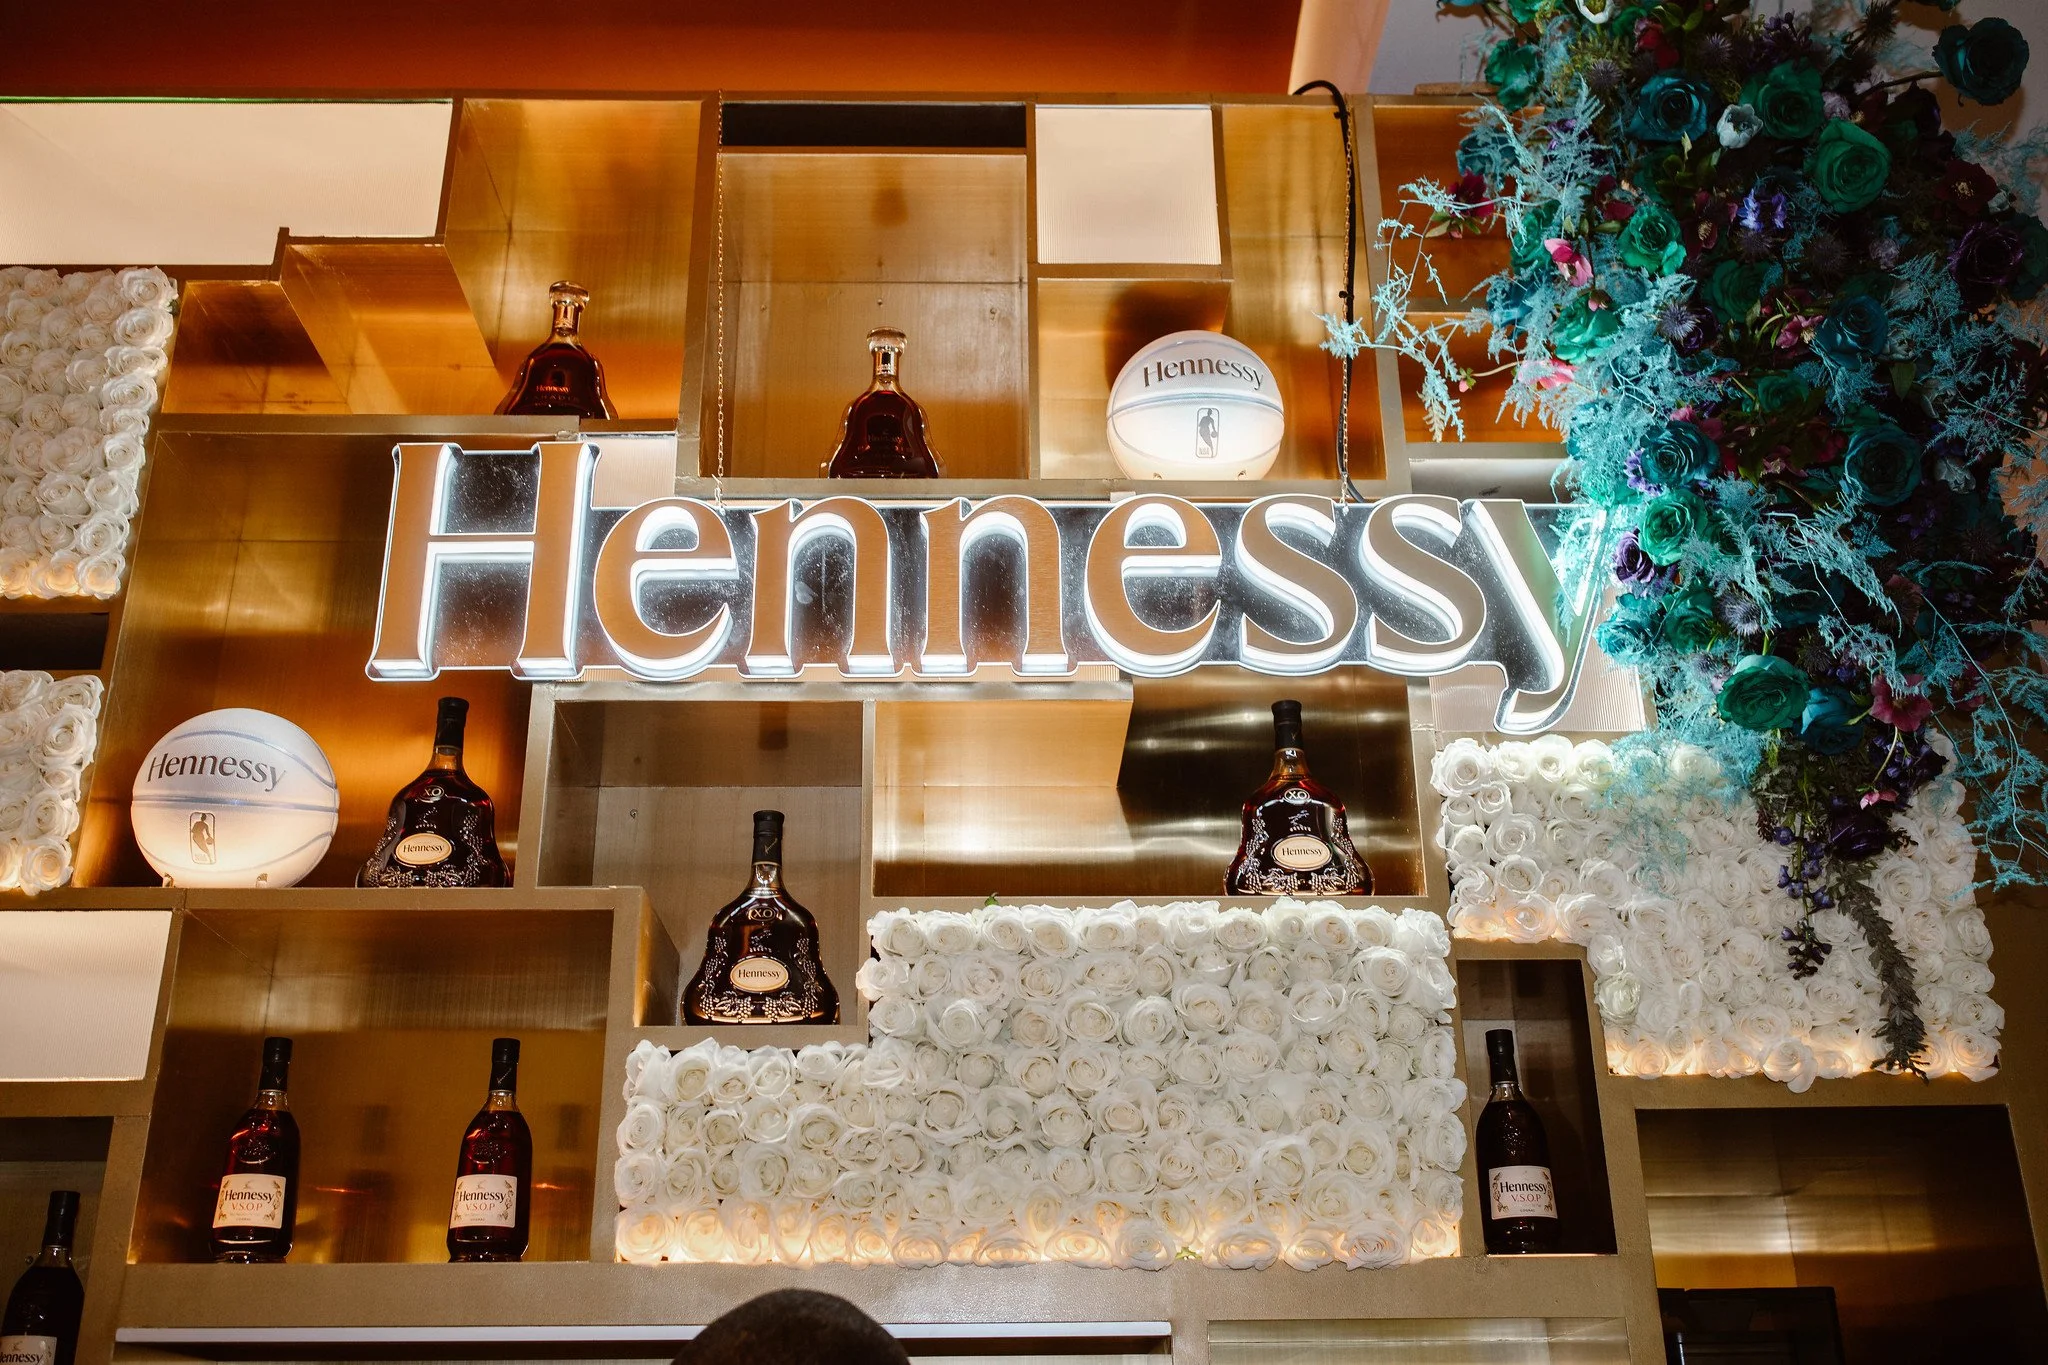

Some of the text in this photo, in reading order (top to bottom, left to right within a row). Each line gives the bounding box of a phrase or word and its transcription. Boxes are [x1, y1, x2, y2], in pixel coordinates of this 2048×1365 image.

[1144, 357, 1264, 391] Hennessy
[368, 441, 1608, 733] Hennessy
[147, 752, 286, 792] Hennessy
[403, 844, 445, 853] Hennessy
[1282, 847, 1323, 857] Hennessy
[738, 968, 781, 980] Hennessy
[1500, 1181, 1548, 1194] Hennessy
[225, 1189, 275, 1204] Hennessy
[459, 1190, 507, 1203] Hennessy
[1511, 1193, 1542, 1203] V.S.O.P
[231, 1202, 263, 1211] V.S.O.P
[465, 1202, 496, 1211] V.S.O.P
